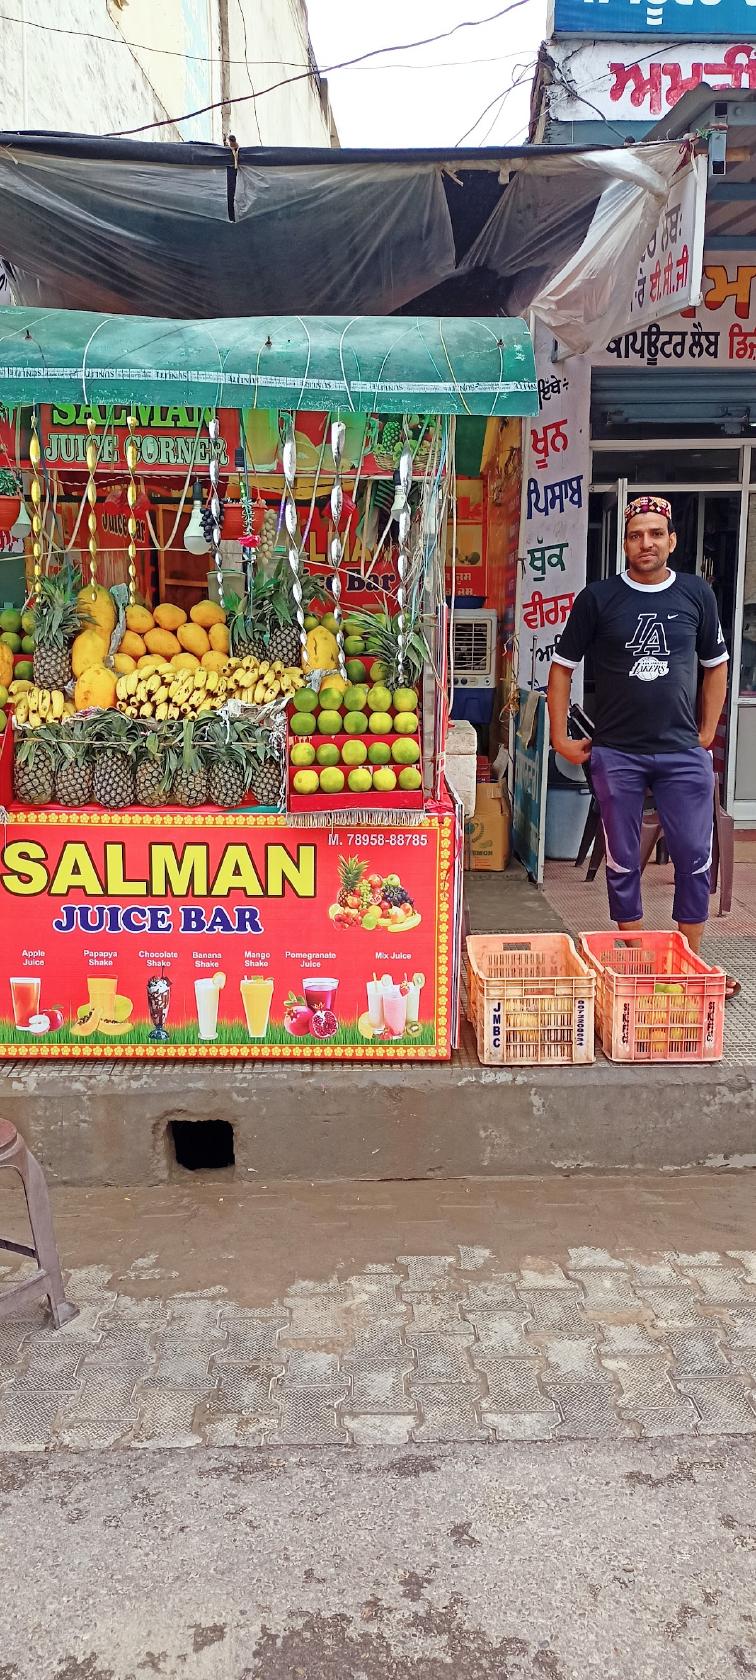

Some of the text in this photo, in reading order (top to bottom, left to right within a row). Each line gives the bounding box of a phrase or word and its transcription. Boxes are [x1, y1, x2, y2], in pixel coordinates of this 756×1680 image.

[45, 434, 229, 466] JUICE CORNER
[345, 567, 397, 593] Bar
[625, 613, 671, 657] LA
[328, 833, 428, 847] M. 78958-88785
[1, 839, 317, 898] SALMAN
[53, 905, 263, 935] JUICE BAR
[22, 949, 46, 959] Apple
[138, 951, 178, 959] Chocolate
[244, 951, 271, 960] Mango
[285, 951, 337, 961] Pomegranate
[375, 952, 412, 960] Mix Juice
[194, 960, 219, 968] Shake
